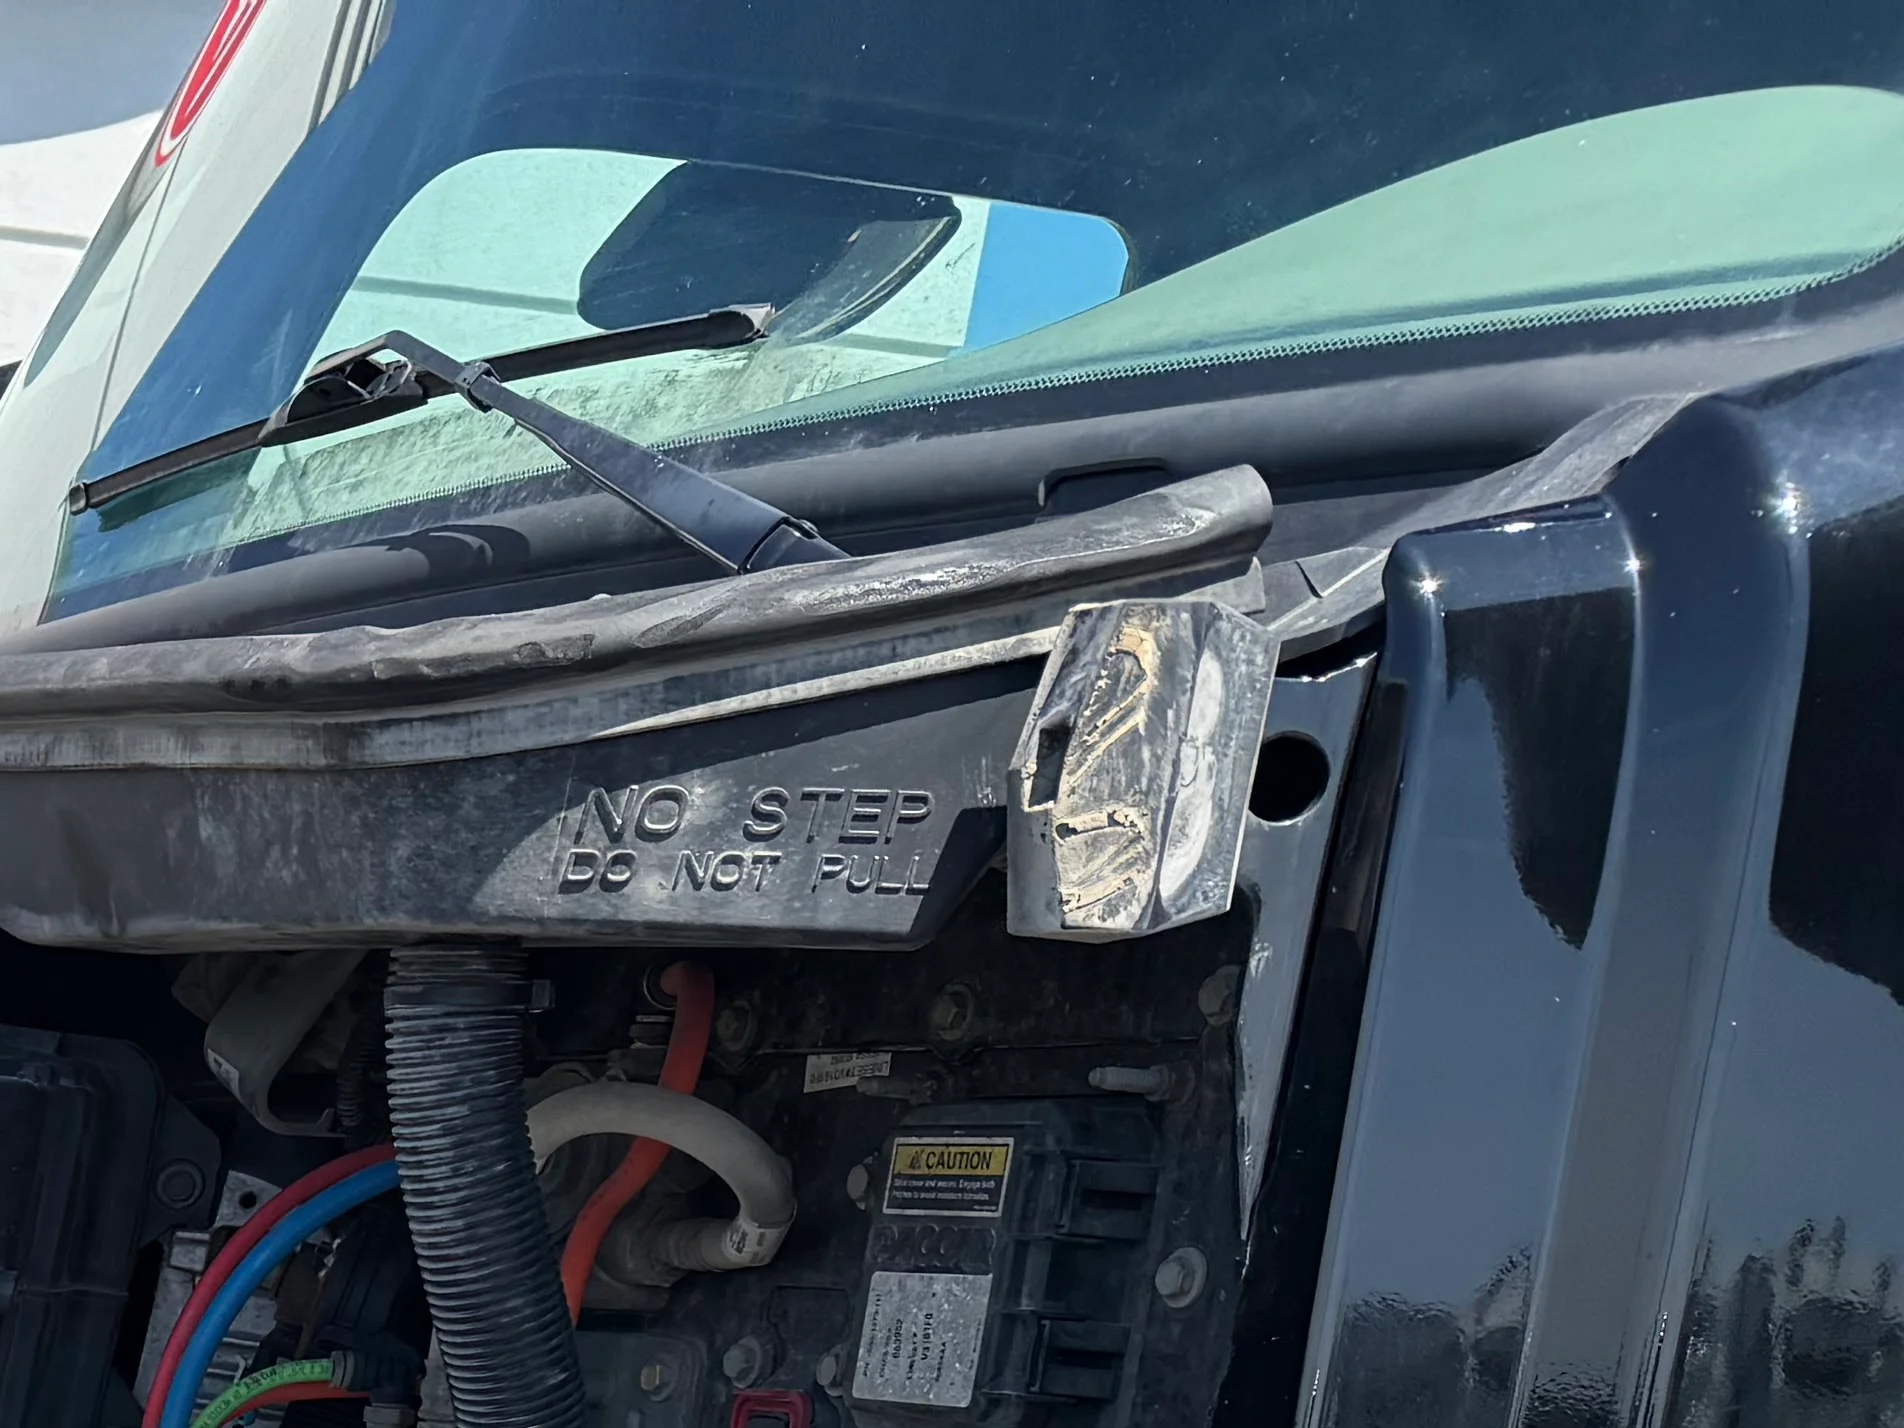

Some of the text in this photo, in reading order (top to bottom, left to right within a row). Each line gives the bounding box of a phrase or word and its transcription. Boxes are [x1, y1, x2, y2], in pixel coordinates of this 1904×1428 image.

[575, 784, 934, 845] NO STEP
[558, 848, 933, 896] DO NOT PULL
[925, 1150, 993, 1171] CAUTION
